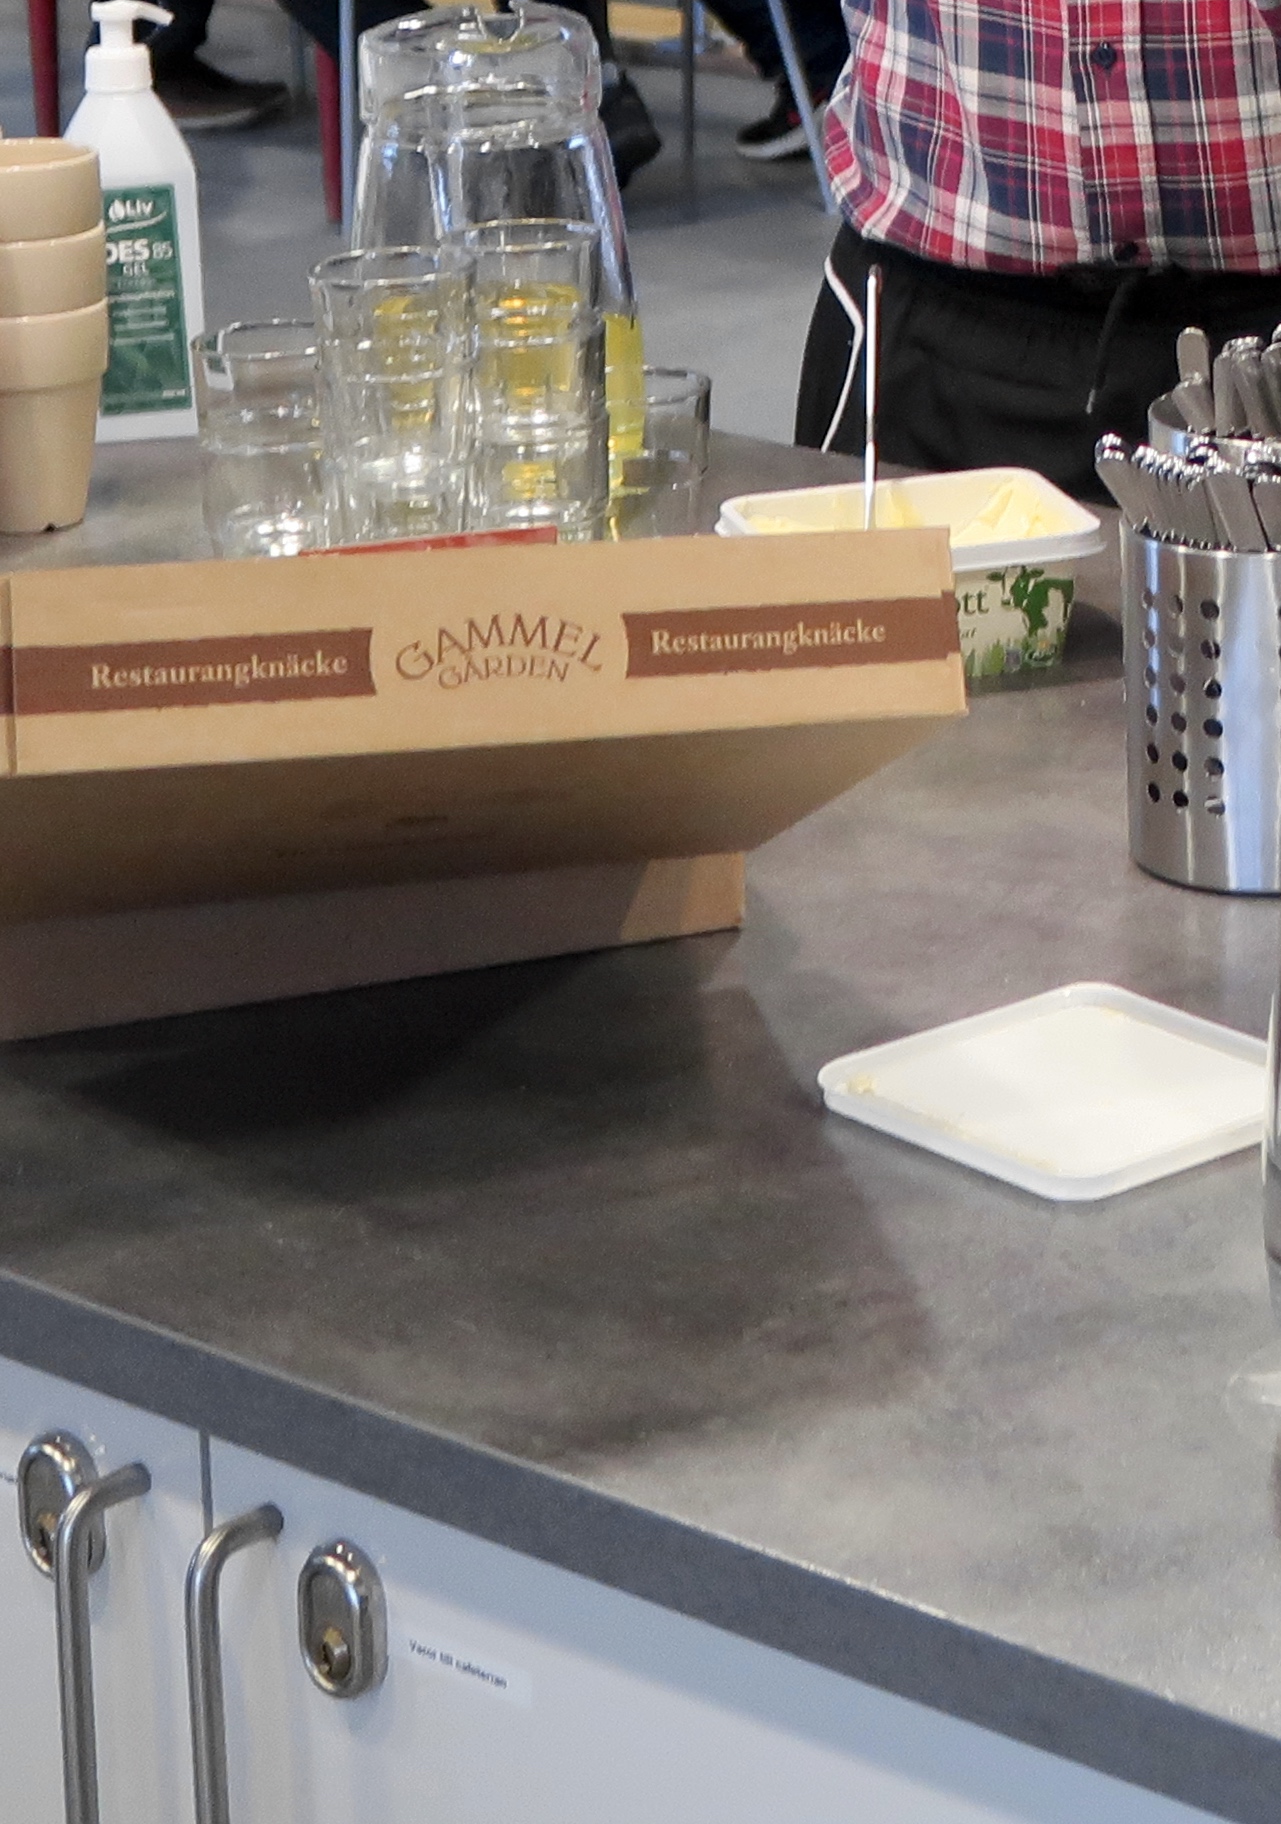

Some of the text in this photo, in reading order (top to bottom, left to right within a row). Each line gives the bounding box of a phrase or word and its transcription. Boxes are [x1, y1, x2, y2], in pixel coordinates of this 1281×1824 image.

[395, 613, 603, 680] GAMMEL
[651, 619, 886, 656] Restaurangknäcke
[91, 649, 348, 689] Restaurangknäcke
